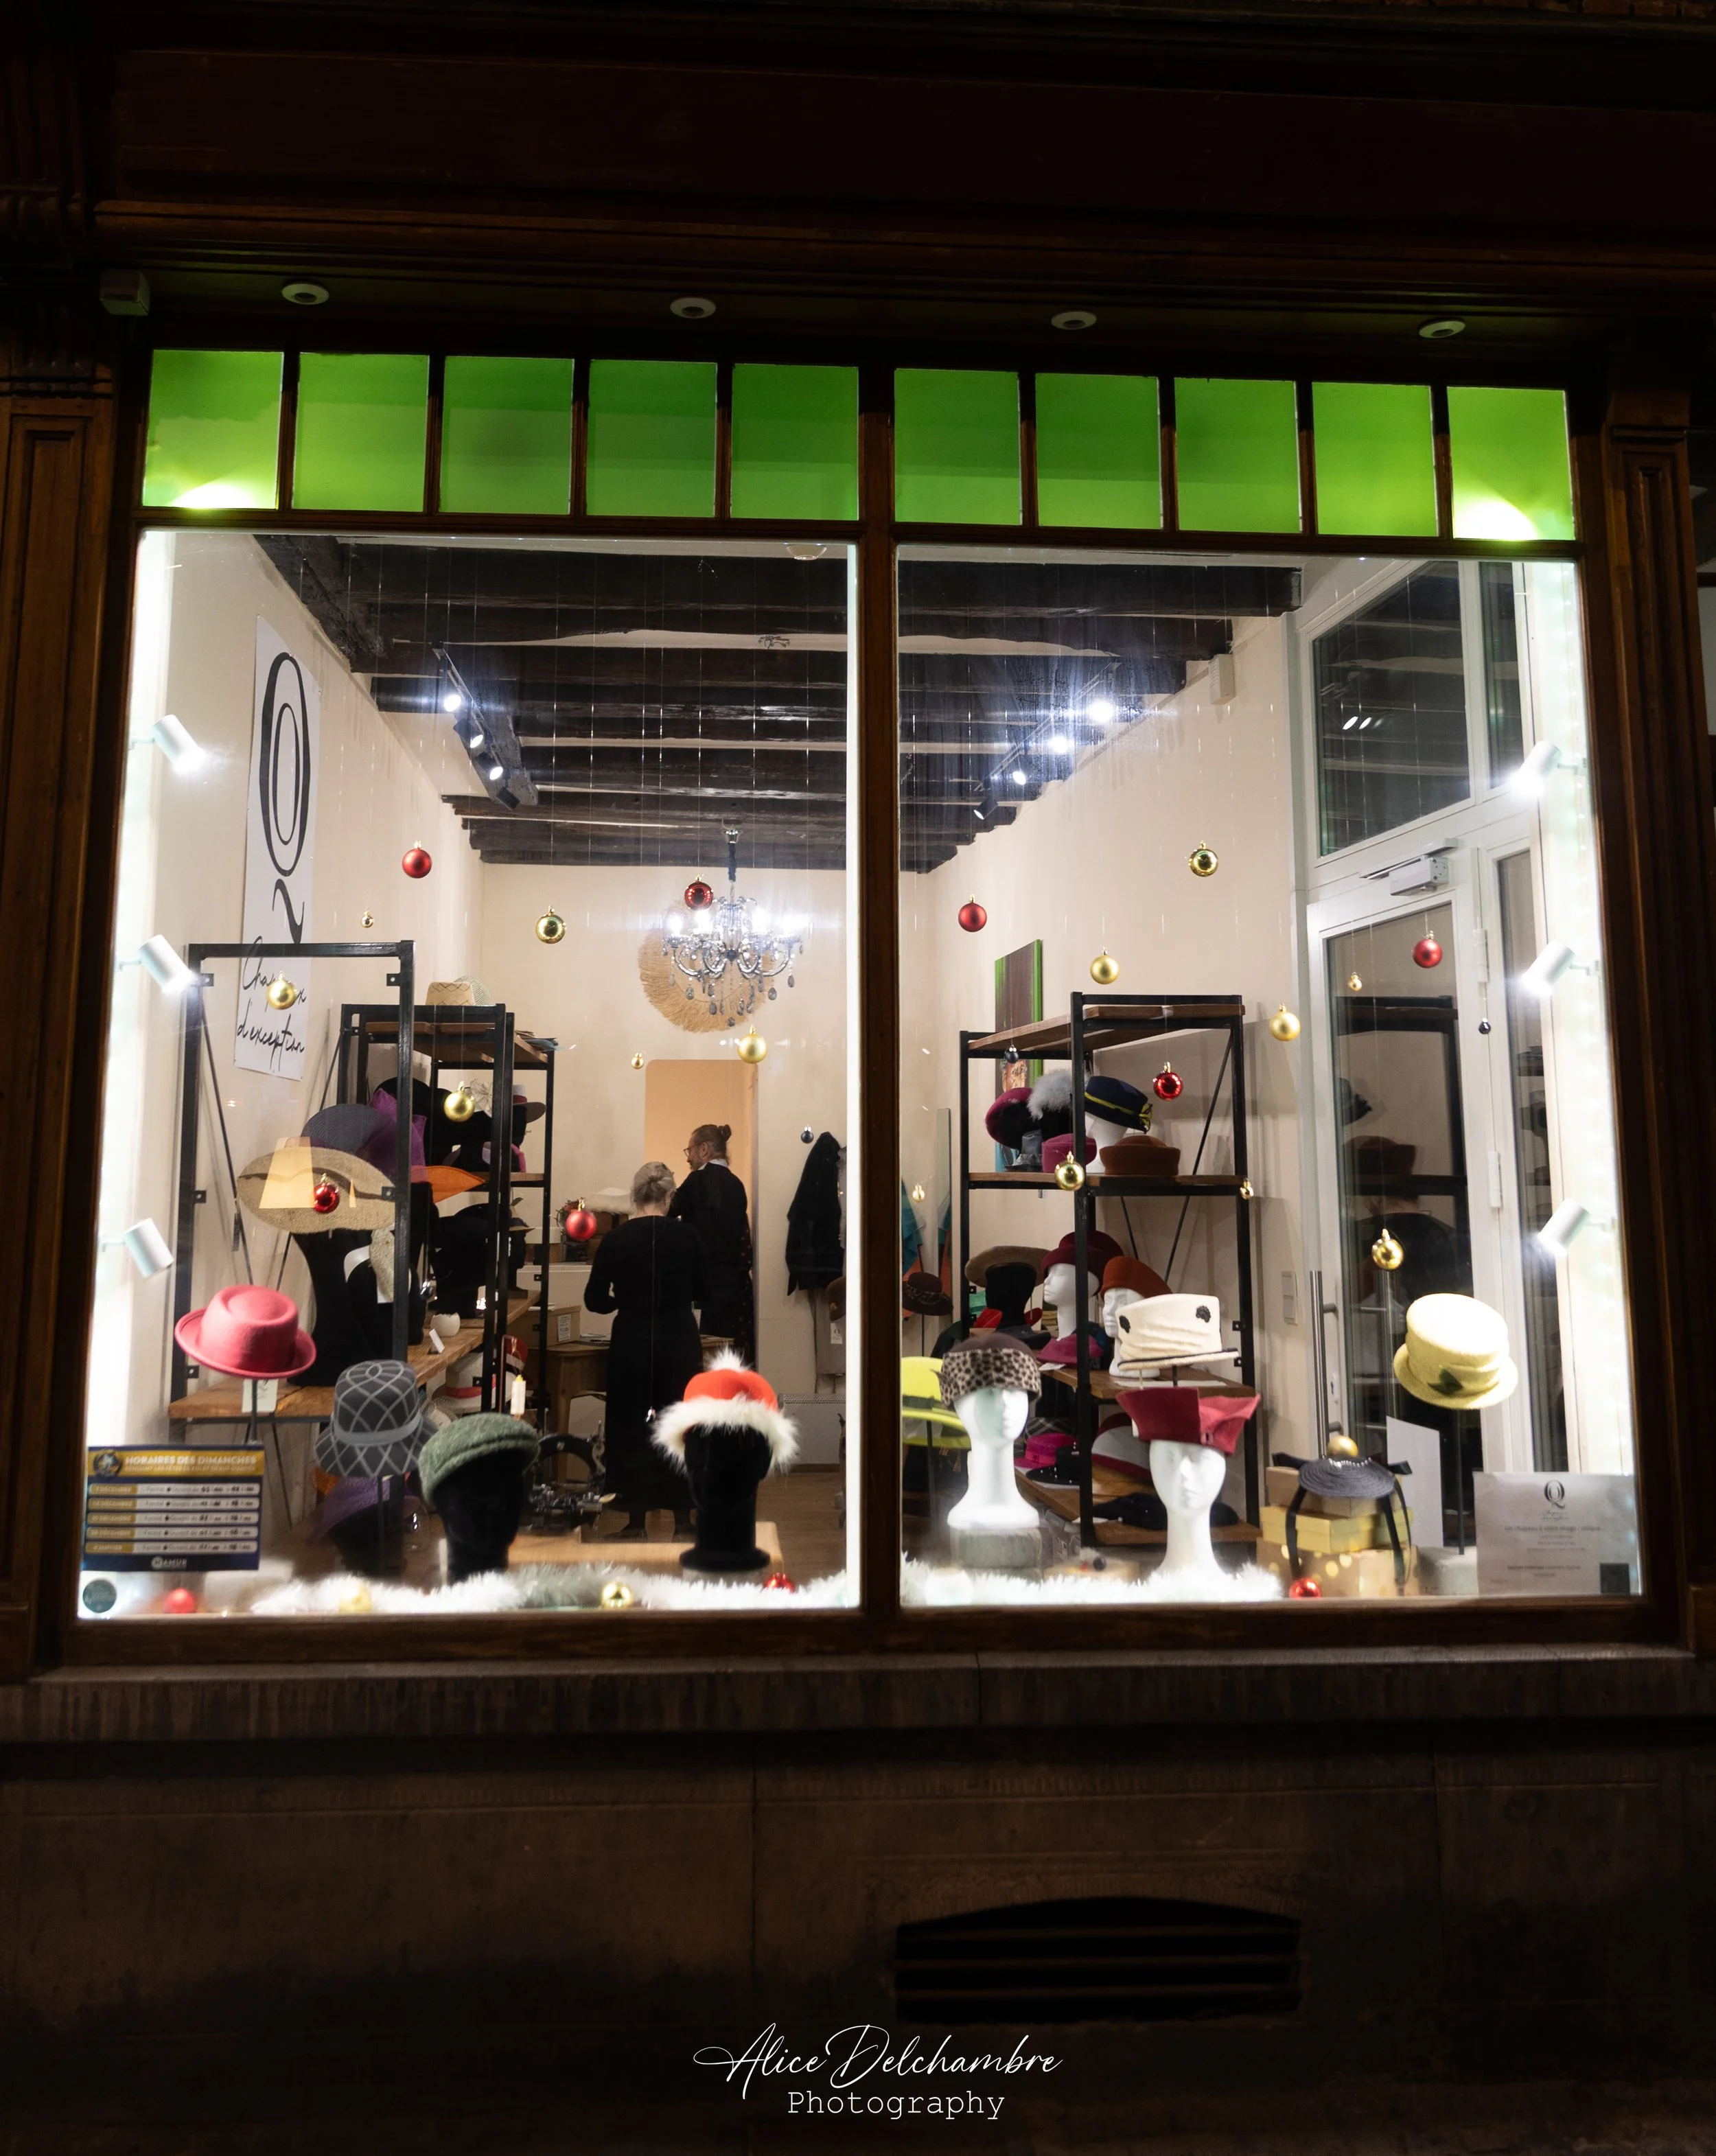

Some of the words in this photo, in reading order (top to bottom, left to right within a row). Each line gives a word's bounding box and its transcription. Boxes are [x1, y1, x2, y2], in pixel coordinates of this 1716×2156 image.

[125, 1456, 176, 1465] HORAIRES
[177, 1456, 196, 1465] DES
[198, 1456, 257, 1464] DIMANCHES
[1544, 1479, 1566, 1509] Q
